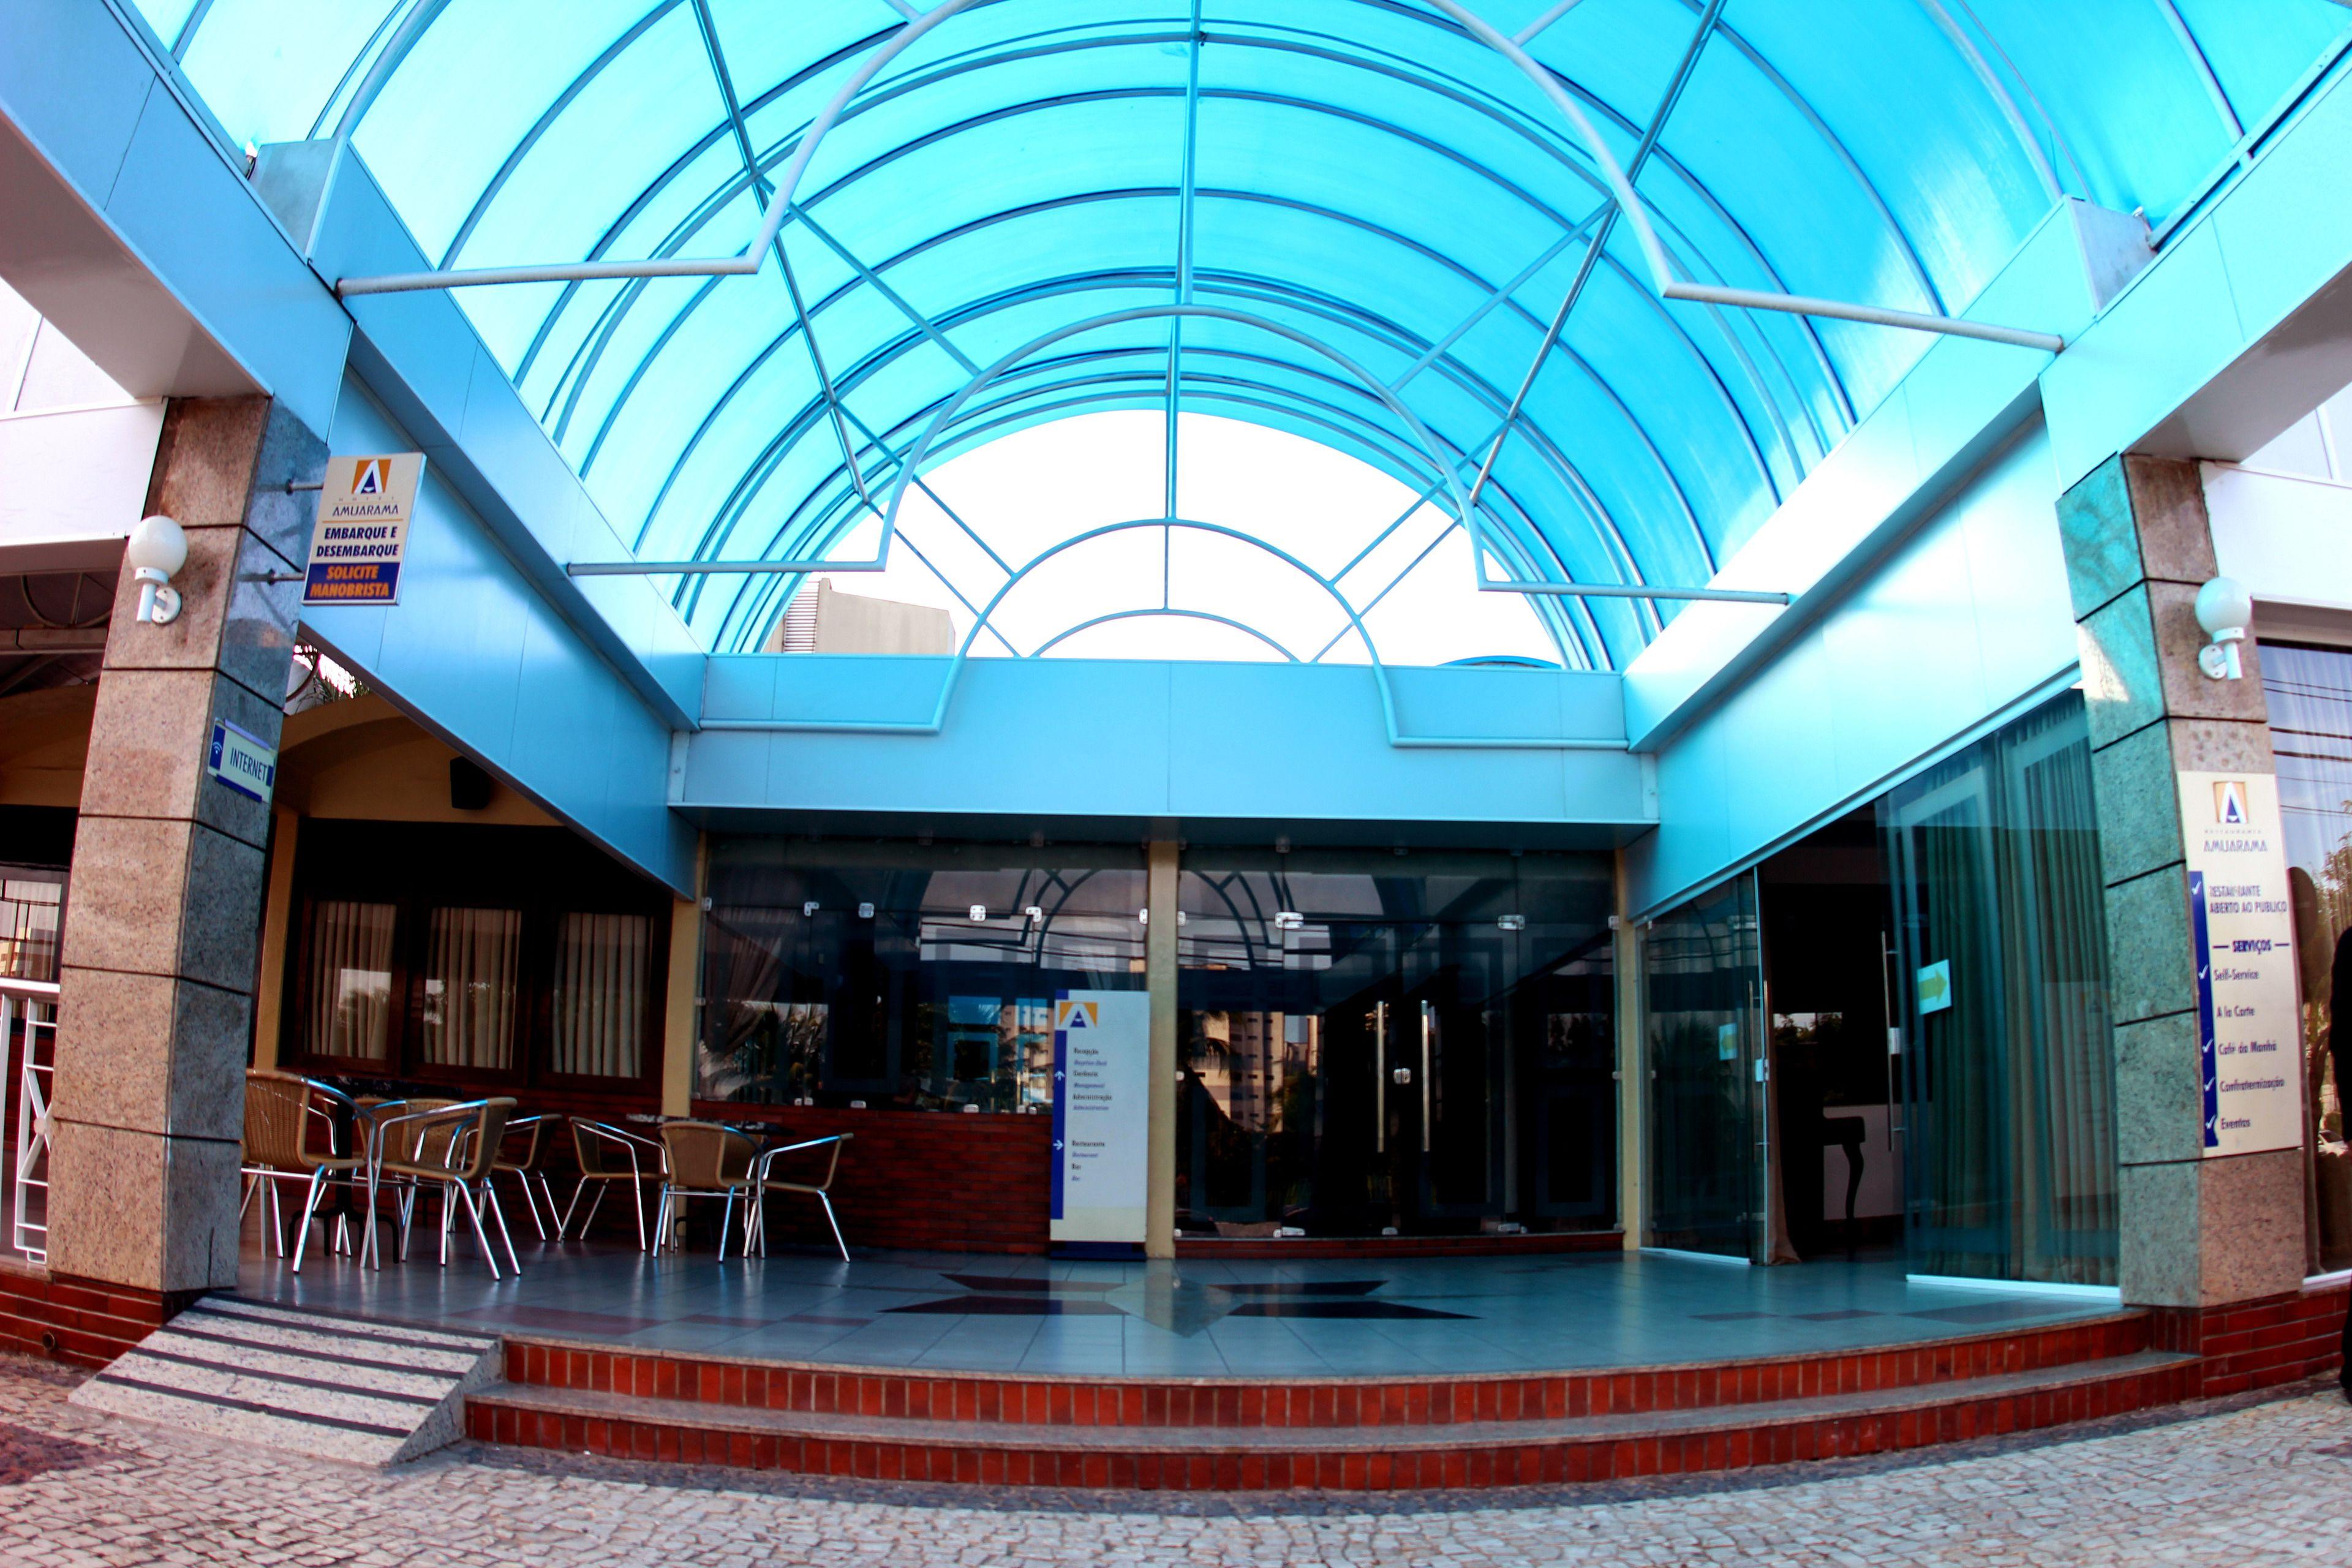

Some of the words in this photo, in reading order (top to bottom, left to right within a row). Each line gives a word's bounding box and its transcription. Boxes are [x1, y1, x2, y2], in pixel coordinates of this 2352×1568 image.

[333, 504, 398, 516] AMUARAMA
[325, 527, 388, 540] EMBARQUE
[391, 526, 398, 538] E
[317, 543, 399, 557] DESEMBARQUE
[326, 565, 379, 580] SOLICITE
[309, 582, 390, 598] MANOBRISTA
[230, 747, 268, 782] INTERNET
[2203, 839, 2267, 853] AMUARAMA
[2210, 902, 2239, 913] ABERTO
[2242, 901, 2253, 913] AO
[2233, 939, 2271, 954] SERVIÇOS
[2214, 968, 2259, 981] Self-Service
[2217, 1006, 2222, 1017] A
[2234, 1005, 2255, 1017] Carte
[2218, 1042, 2236, 1055] Café
[2238, 1042, 2248, 1054] da
[2221, 1117, 2250, 1129] Eventos
